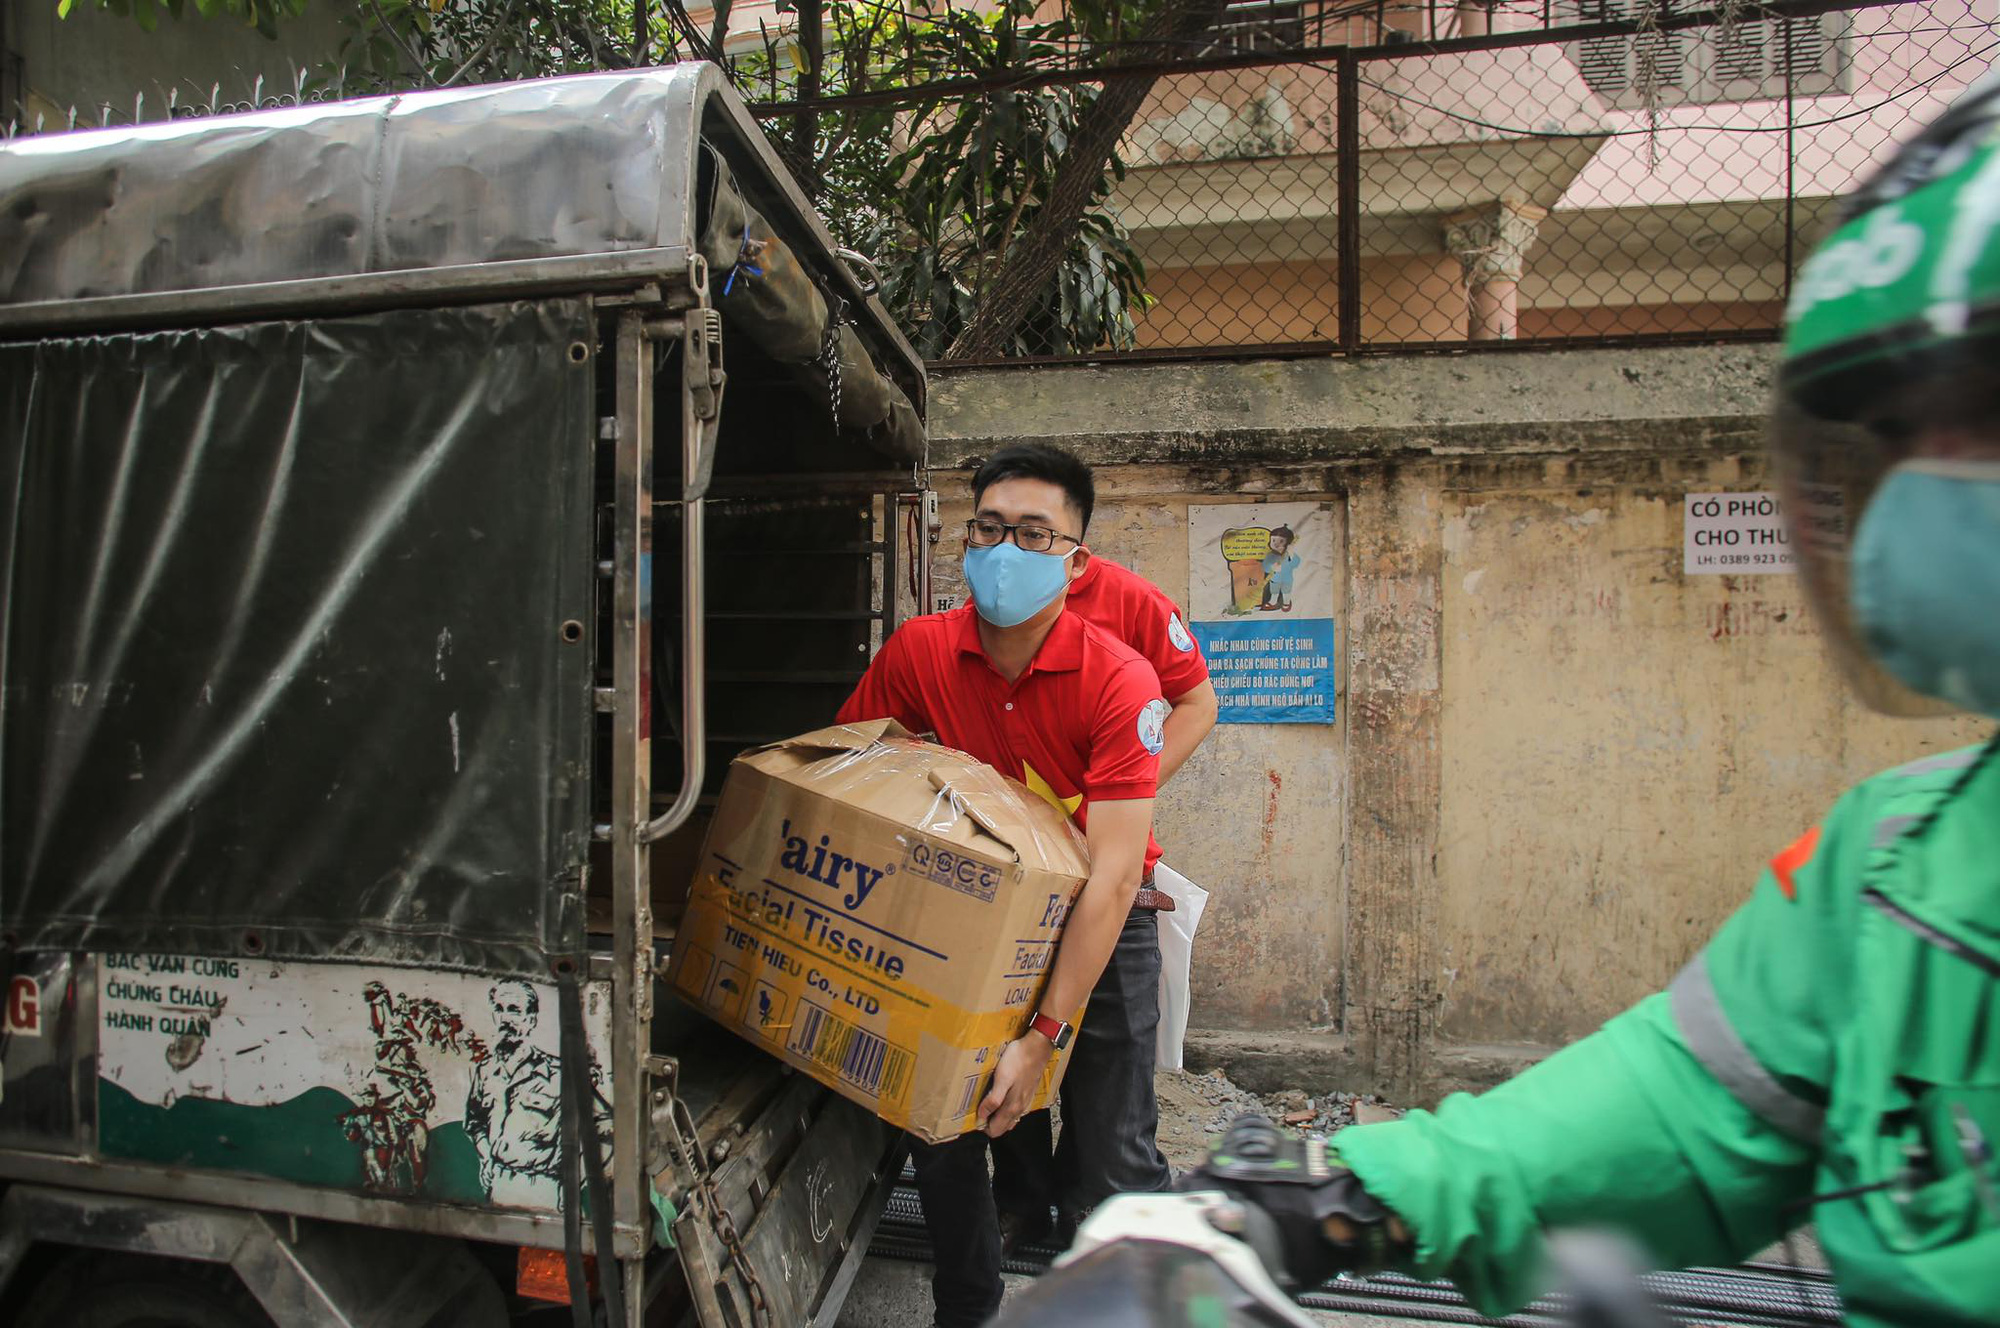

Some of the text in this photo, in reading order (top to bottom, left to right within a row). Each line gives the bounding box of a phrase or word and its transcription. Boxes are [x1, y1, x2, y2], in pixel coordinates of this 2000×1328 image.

[1691, 497, 1720, 517] CÓ
[1728, 496, 1782, 516] PHÒ
[1695, 529, 1790, 546] CHO THU
[1697, 554, 1717, 565] LH:
[1720, 554, 1750, 564] 0389
[1754, 554, 1776, 564] 923
[1230, 639, 1249, 651] NHAU
[1296, 638, 1313, 650] SINH
[1224, 658, 1233, 670] BA
[1280, 657, 1289, 669] TA
[780, 819, 883, 910] airy
[804, 908, 904, 981] Tissue
[844, 986, 880, 1016] LTD
